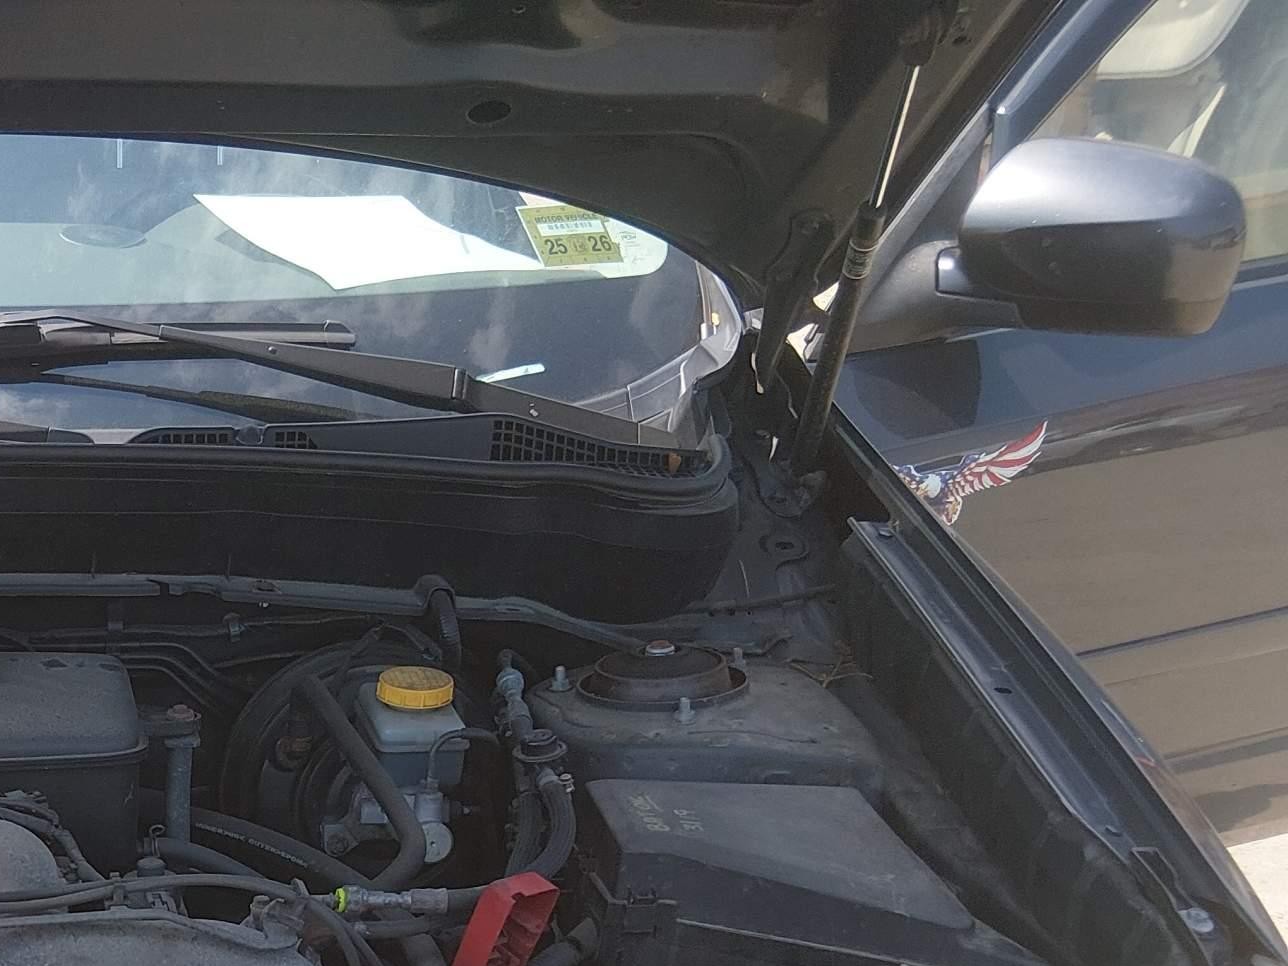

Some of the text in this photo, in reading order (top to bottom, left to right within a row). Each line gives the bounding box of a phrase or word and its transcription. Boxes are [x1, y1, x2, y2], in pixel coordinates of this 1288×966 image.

[534, 214, 566, 224] MOTOR
[544, 238, 569, 256] 25
[587, 235, 613, 252] 26
